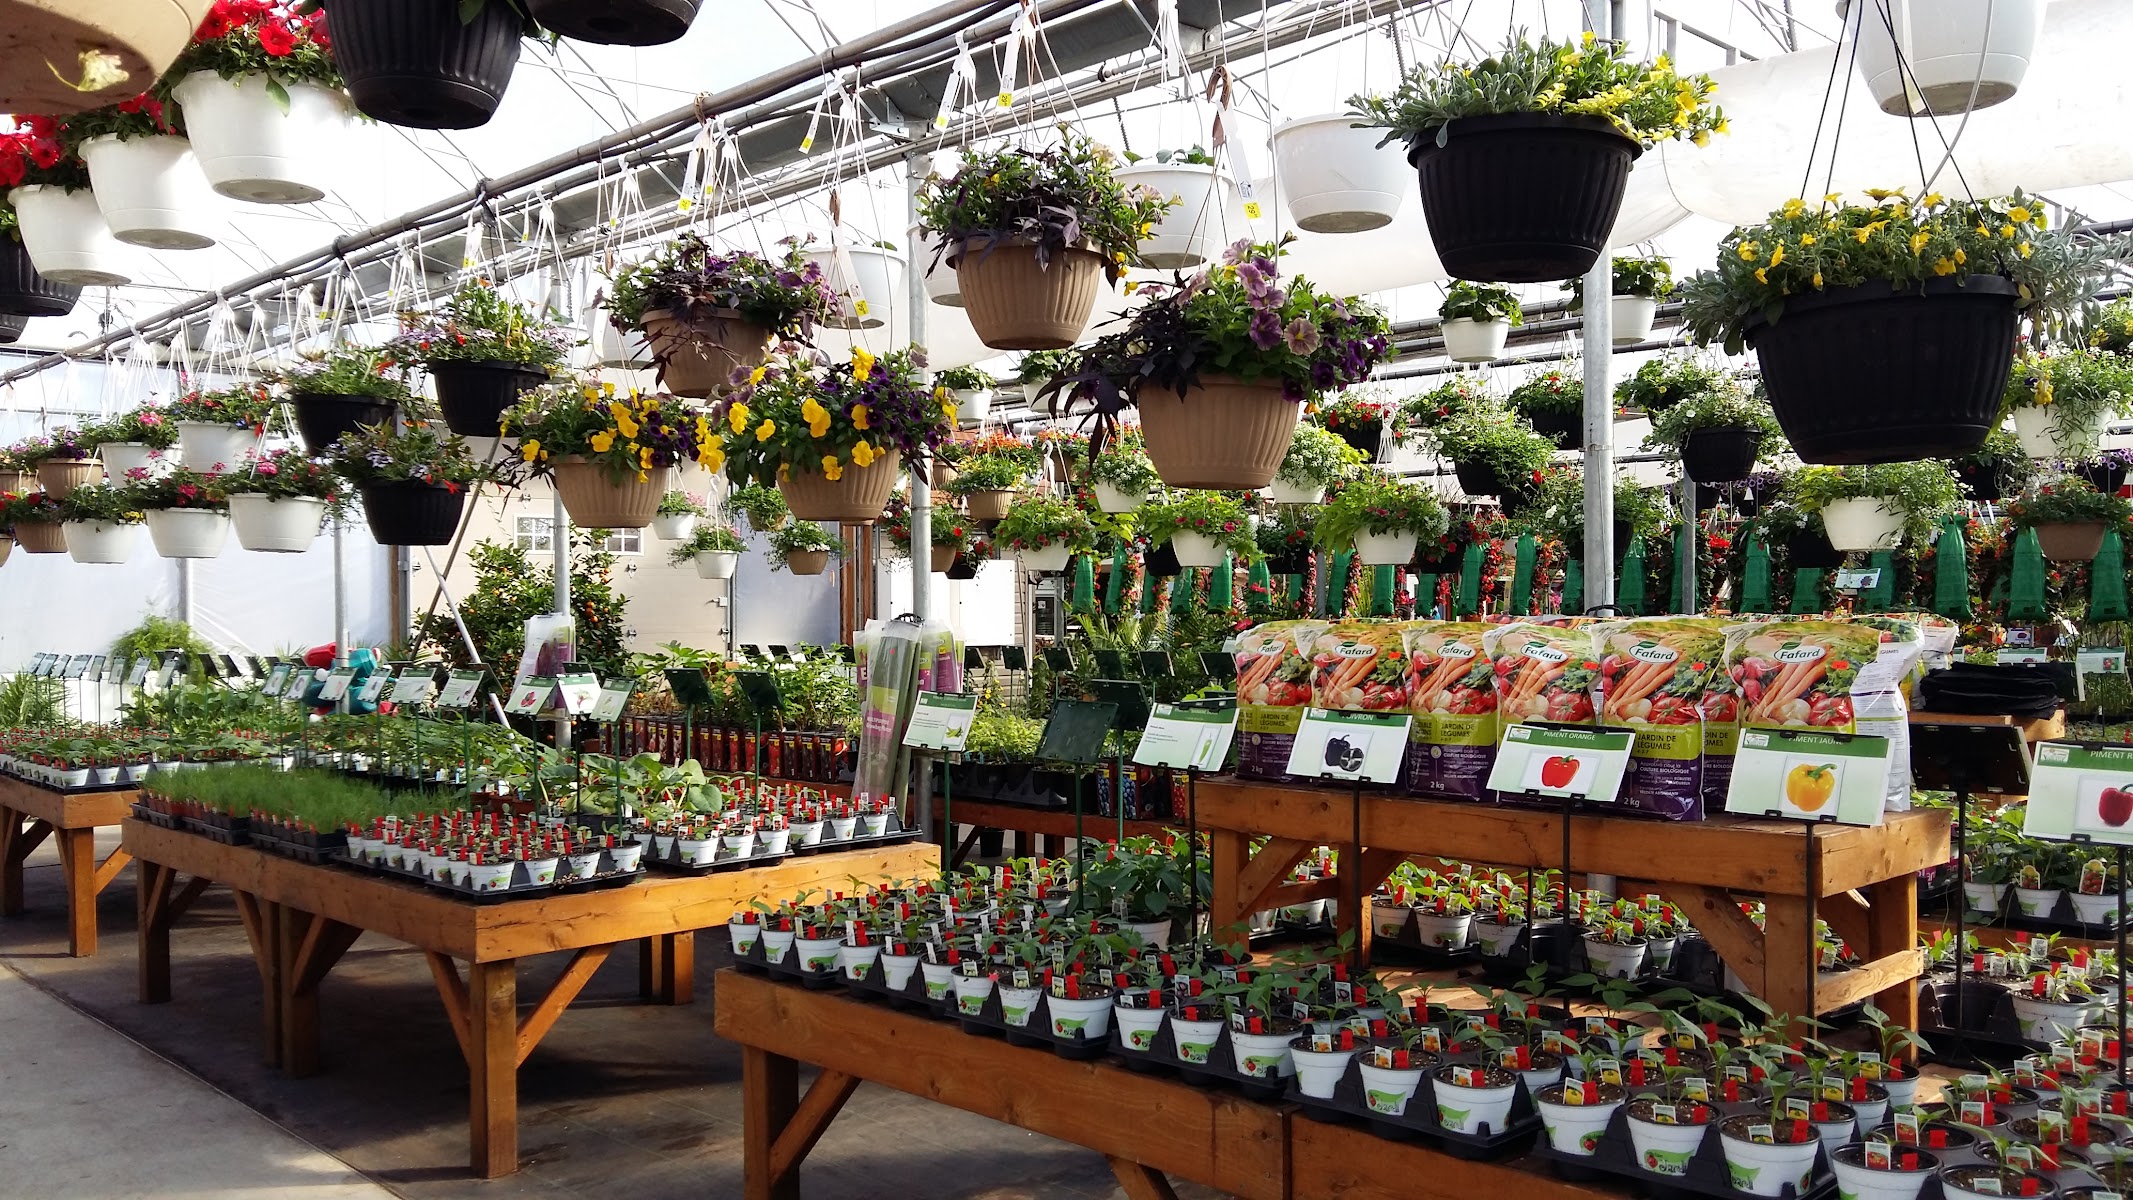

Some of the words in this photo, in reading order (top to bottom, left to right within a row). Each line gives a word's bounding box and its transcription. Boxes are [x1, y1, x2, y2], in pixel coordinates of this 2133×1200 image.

[1339, 646, 1373, 656] Fafard
[1440, 646, 1473, 657] Fafard
[1524, 646, 1563, 660] Fafard
[1634, 648, 1675, 660] Fafard
[1781, 648, 1820, 660] Fafard
[1341, 713, 1374, 721] OIVRON
[1465, 723, 1475, 731] DE
[1543, 731, 1568, 739] PIMENT
[1568, 732, 1596, 741] ORANGE
[1638, 733, 1664, 741] JARDIN
[2090, 750, 2125, 759] PIMENT
[1255, 765, 1263, 774] kg
[1435, 781, 1445, 790] kg
[1629, 798, 1640, 808] kg
